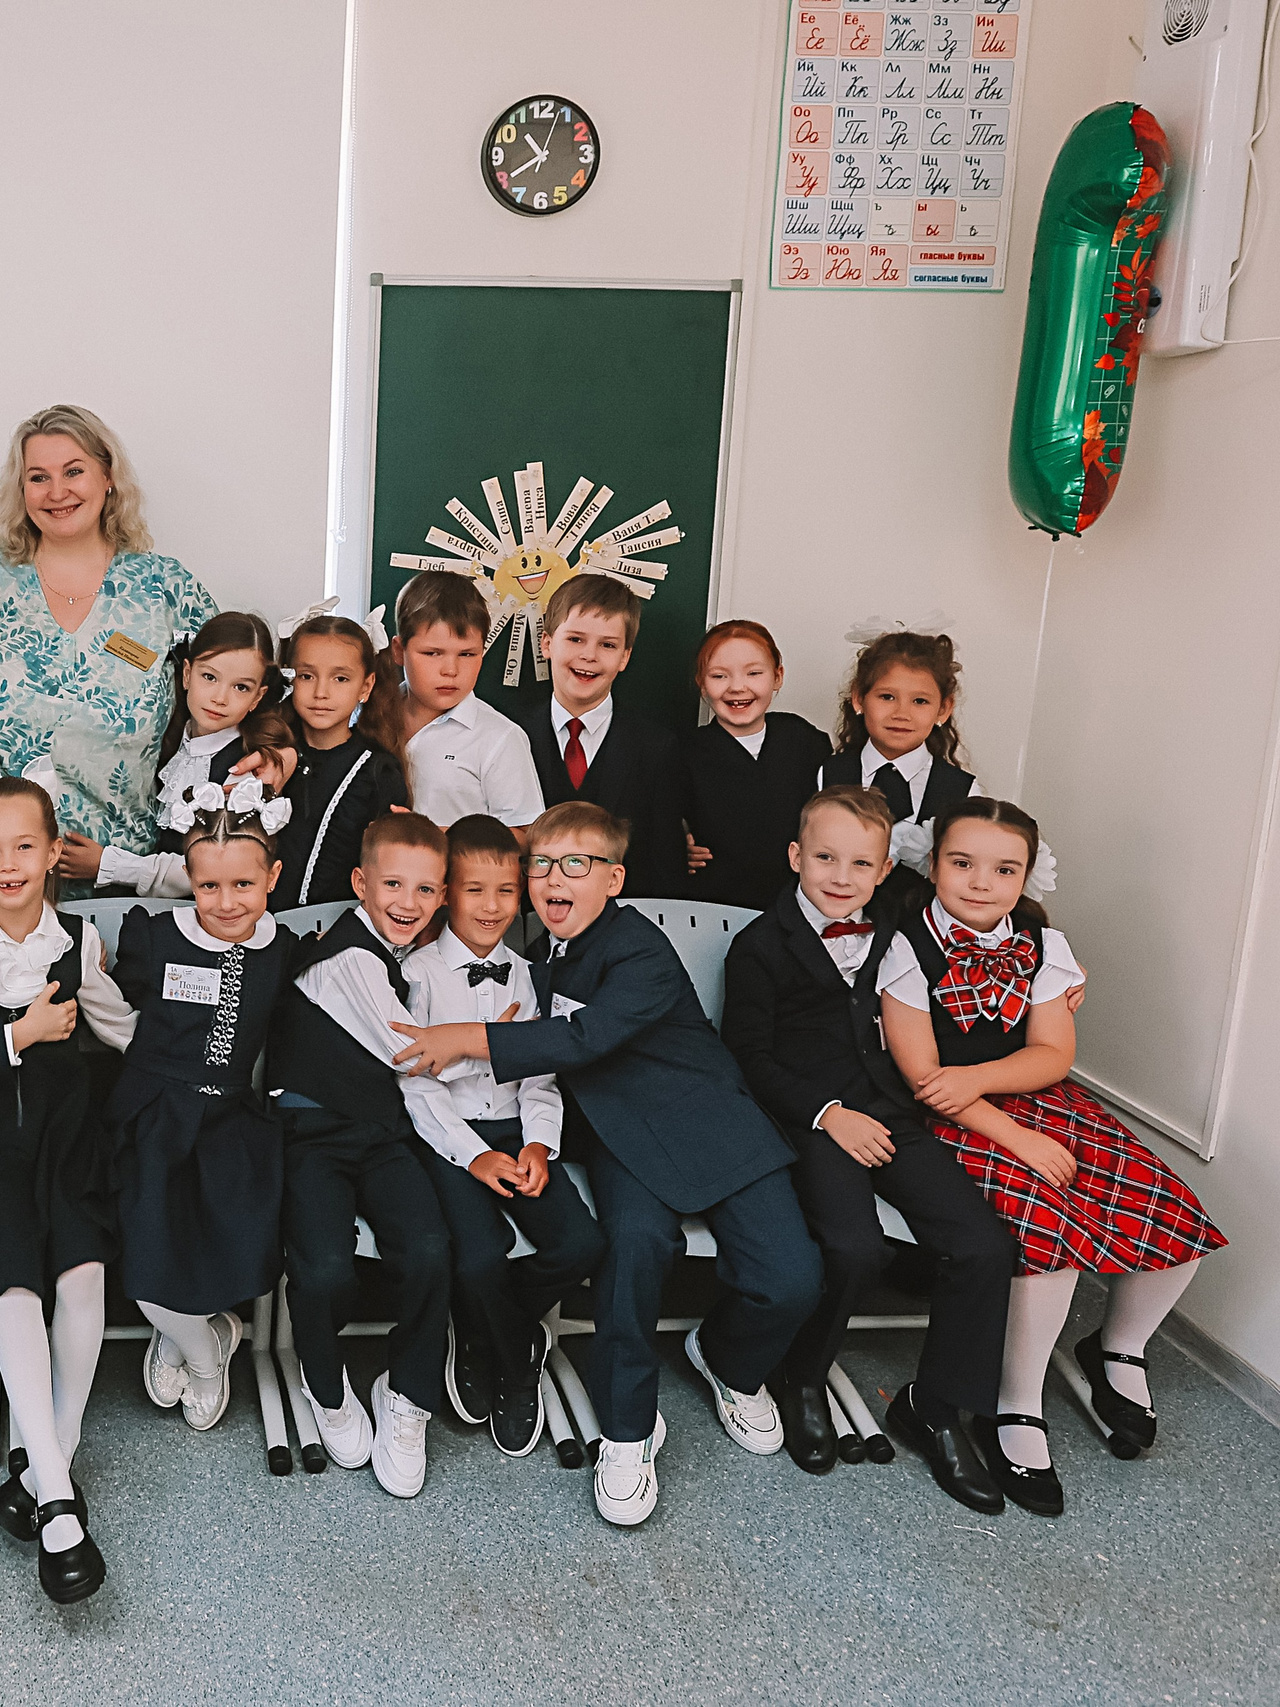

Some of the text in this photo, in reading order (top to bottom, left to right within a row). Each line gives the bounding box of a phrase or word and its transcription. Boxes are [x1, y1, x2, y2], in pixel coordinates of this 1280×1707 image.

[801, 13, 994, 27] Ее Ёё Жж Зз Ии
[798, 62, 990, 74] Йй Кк Лл Мм Нн
[529, 101, 554, 119] 12
[560, 106, 572, 122] 1
[794, 107, 982, 119] Оо Пп Рр Сс Тт
[574, 122, 588, 141] 2
[491, 144, 594, 166] 9 3
[791, 154, 980, 167] Уу Фф Хх Цц Чч
[571, 169, 586, 188] 4
[512, 186, 568, 210] 7 6 5
[787, 200, 809, 210] Шш
[831, 202, 853, 212] Щщ
[783, 245, 886, 256] Ээ Юю Яя
[524, 489, 534, 534] Валера
[536, 487, 545, 519] Ника
[495, 500, 511, 534] Саша
[556, 503, 579, 531] Вова
[455, 507, 499, 555] Кристина
[612, 522, 642, 541] Ваня
[447, 536, 485, 560] Марта
[618, 538, 662, 555] Таисия
[613, 561, 642, 575] Лиза
